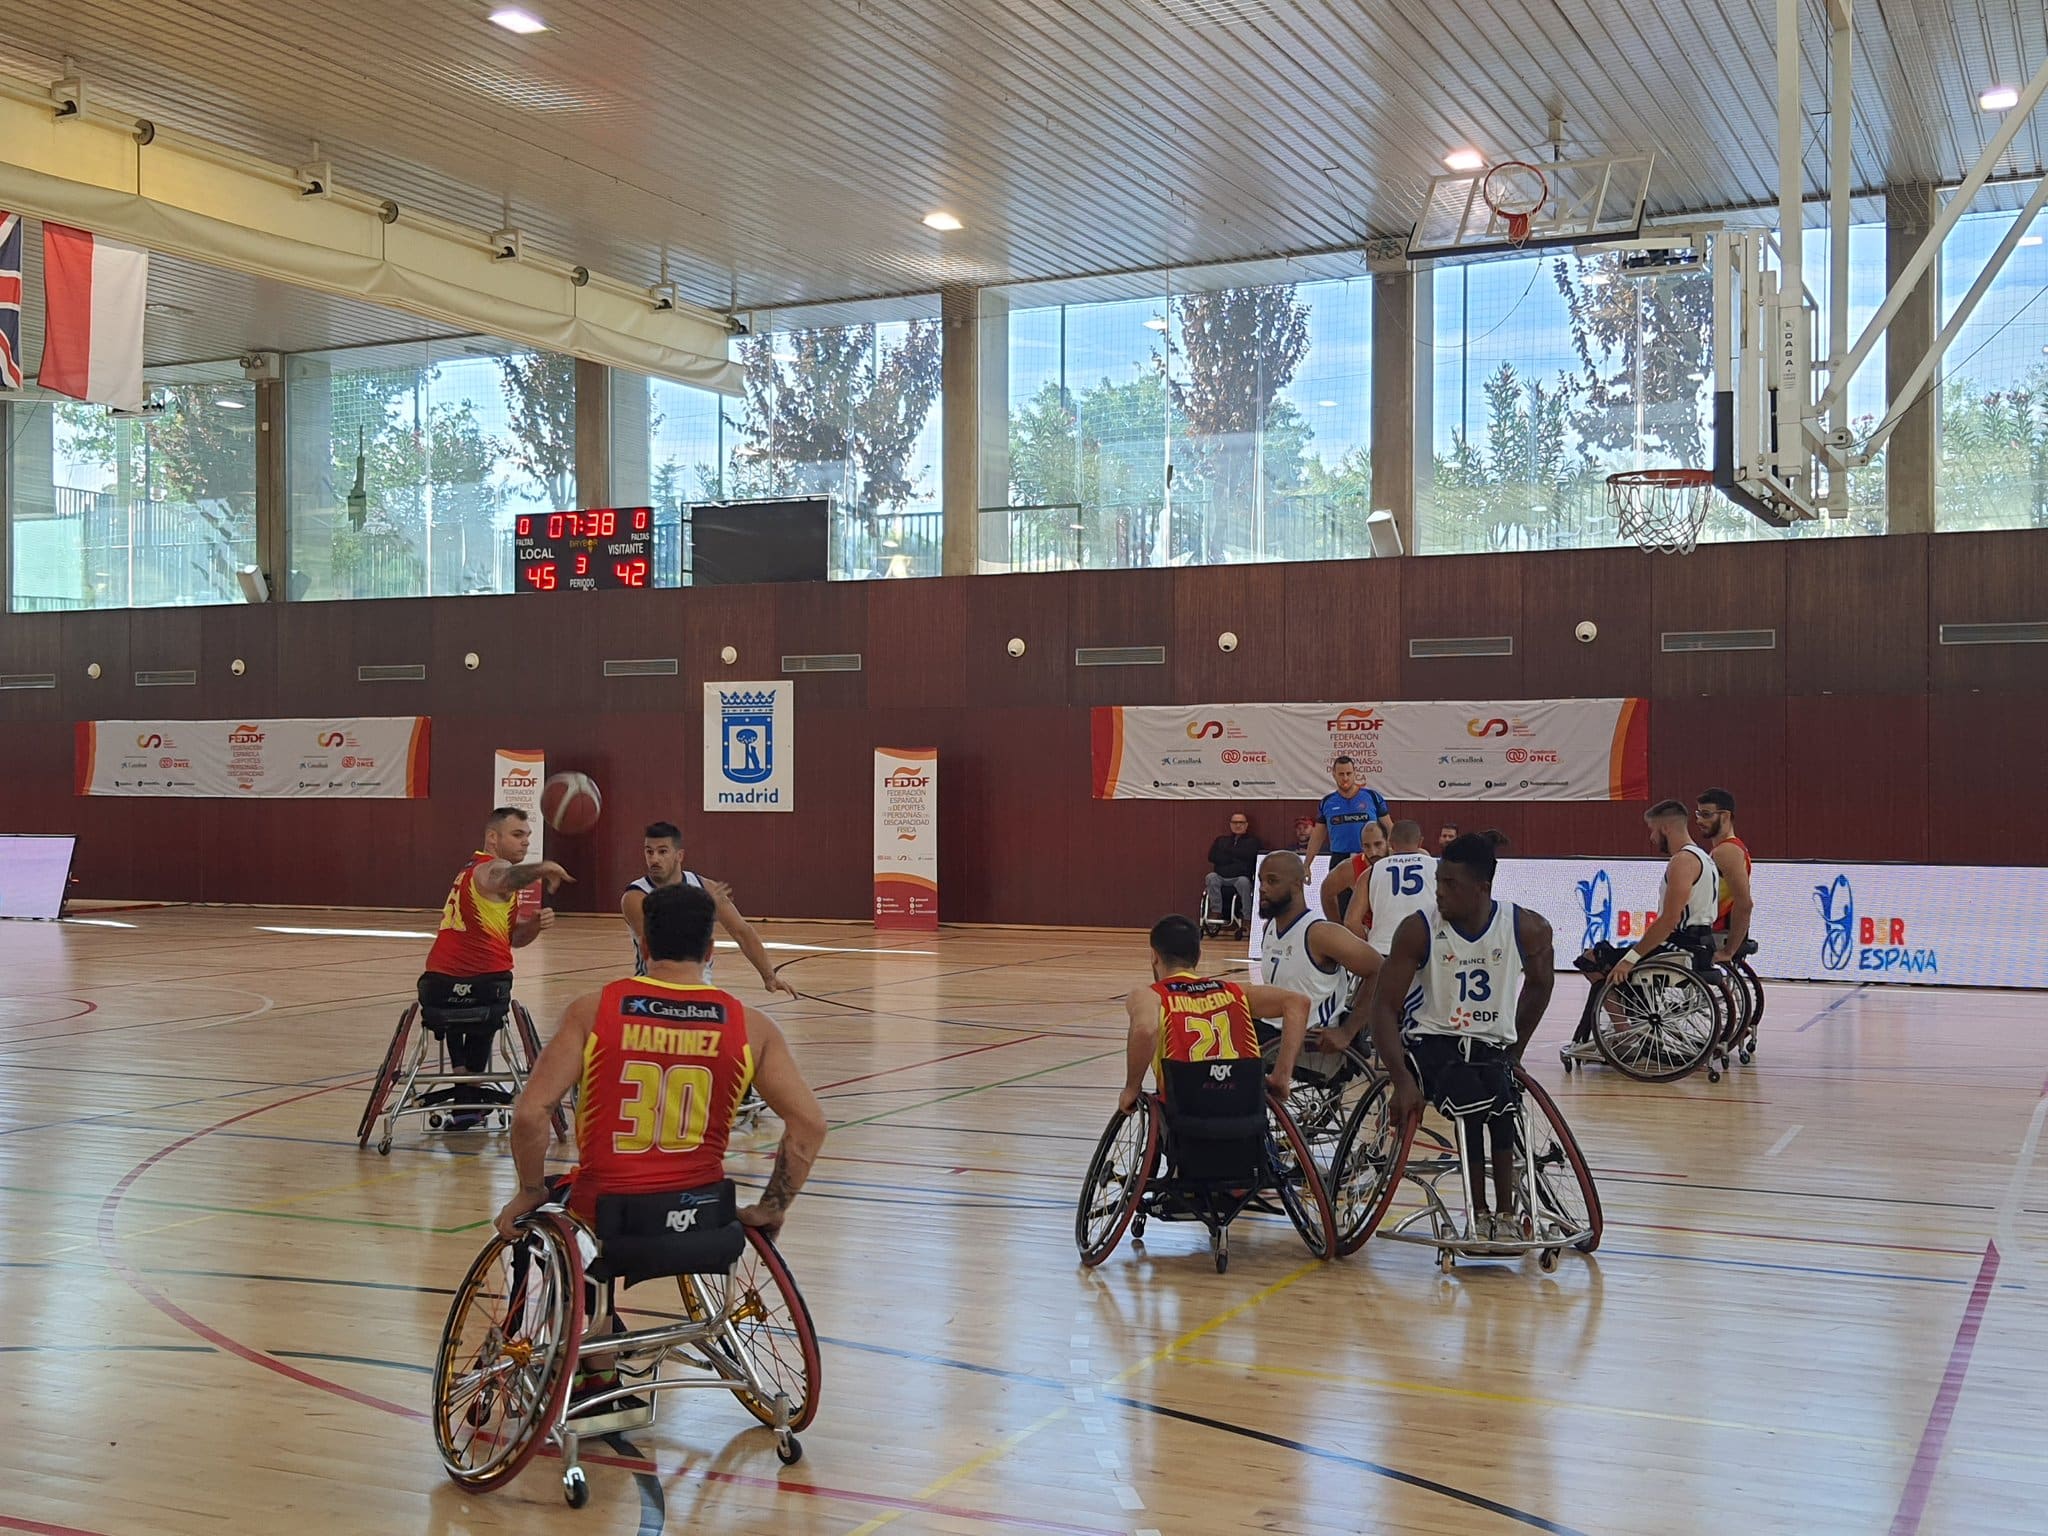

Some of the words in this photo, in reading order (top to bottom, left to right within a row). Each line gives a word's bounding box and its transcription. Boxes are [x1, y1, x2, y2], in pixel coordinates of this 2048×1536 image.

[1784, 332, 1794, 366] DASA
[519, 518, 530, 535] 0
[549, 512, 615, 538] 07:38
[635, 512, 646, 529] 0
[515, 538, 534, 546] FALTAS
[630, 532, 650, 541] FALTAS
[520, 548, 555, 560] LOCAL
[607, 543, 644, 555] VISITANTE
[528, 566, 555, 590] 45
[576, 557, 587, 574] 3
[616, 562, 645, 586] 42
[569, 578, 595, 588] PERIODO
[1327, 719, 1384, 731] FEDDF
[228, 734, 265, 743] FEDDF
[1333, 741, 1375, 749] ESPAÑOLA
[1242, 755, 1267, 763] ONCE
[501, 777, 538, 787] FEDDF
[884, 777, 930, 788] FEDDF
[718, 788, 779, 803] madrid
[1385, 864, 1424, 896] 15
[1859, 947, 1938, 974] ESPAÑA
[1270, 956, 1280, 984] 7
[1454, 968, 1492, 1002] 13
[649, 1001, 719, 1019] CaixaBank
[1167, 989, 1237, 1014] LAVANDEIRA
[622, 1023, 722, 1058] MARTINEZ
[1184, 1010, 1239, 1062] 21
[612, 1060, 713, 1154] 30
